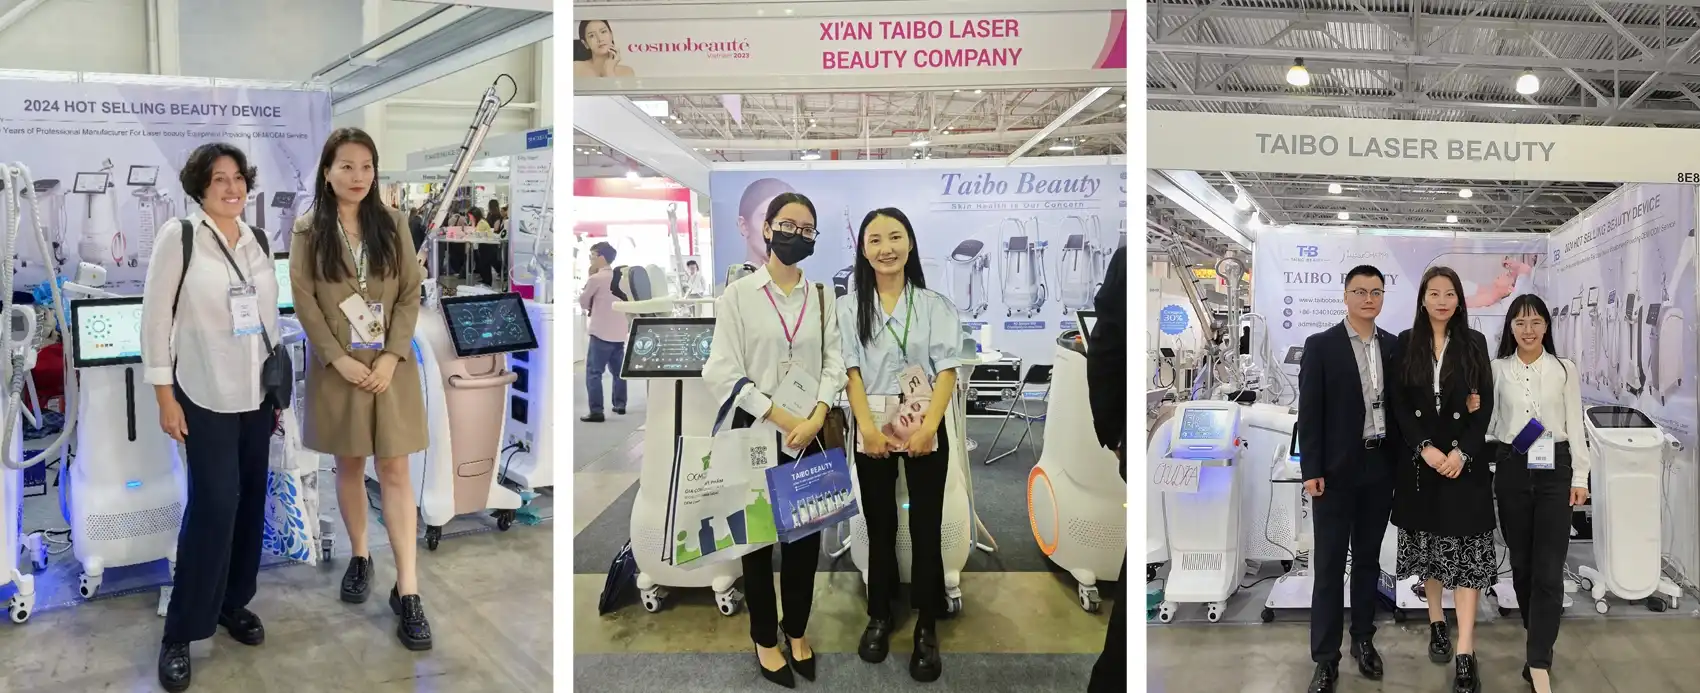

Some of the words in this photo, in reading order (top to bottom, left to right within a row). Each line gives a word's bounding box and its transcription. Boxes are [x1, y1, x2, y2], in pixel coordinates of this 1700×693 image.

[819, 20, 873, 42] XI'AN
[879, 20, 943, 40] TAIBO
[949, 18, 1020, 39] LASER
[627, 37, 751, 54] cosmobeauté
[822, 48, 906, 70] BEAUTY
[913, 47, 1023, 68] COMPANY
[23, 99, 60, 112] 2024
[64, 100, 97, 114] HOT
[101, 102, 166, 115] SELLING
[170, 104, 227, 117] BEAUTY
[232, 106, 281, 118] DEVICE
[3, 127, 25, 135] Years
[36, 128, 81, 136] Professional
[82, 128, 128, 136] Manufacturer
[1256, 133, 1339, 157] TAIBO
[1347, 136, 1438, 160] LASER
[1447, 139, 1556, 163] BEAUTY
[940, 172, 1008, 196] Taibo
[1015, 172, 1101, 198] Beauty
[1043, 201, 1085, 209] Concern
[1607, 210, 1631, 233] BEAUTY
[1632, 194, 1661, 219] DEVICE
[1284, 271, 1332, 284] TAIBO
[1163, 314, 1184, 322] 30%
[791, 468, 810, 481] TAIBO
[809, 461, 833, 475] BEAUTY
